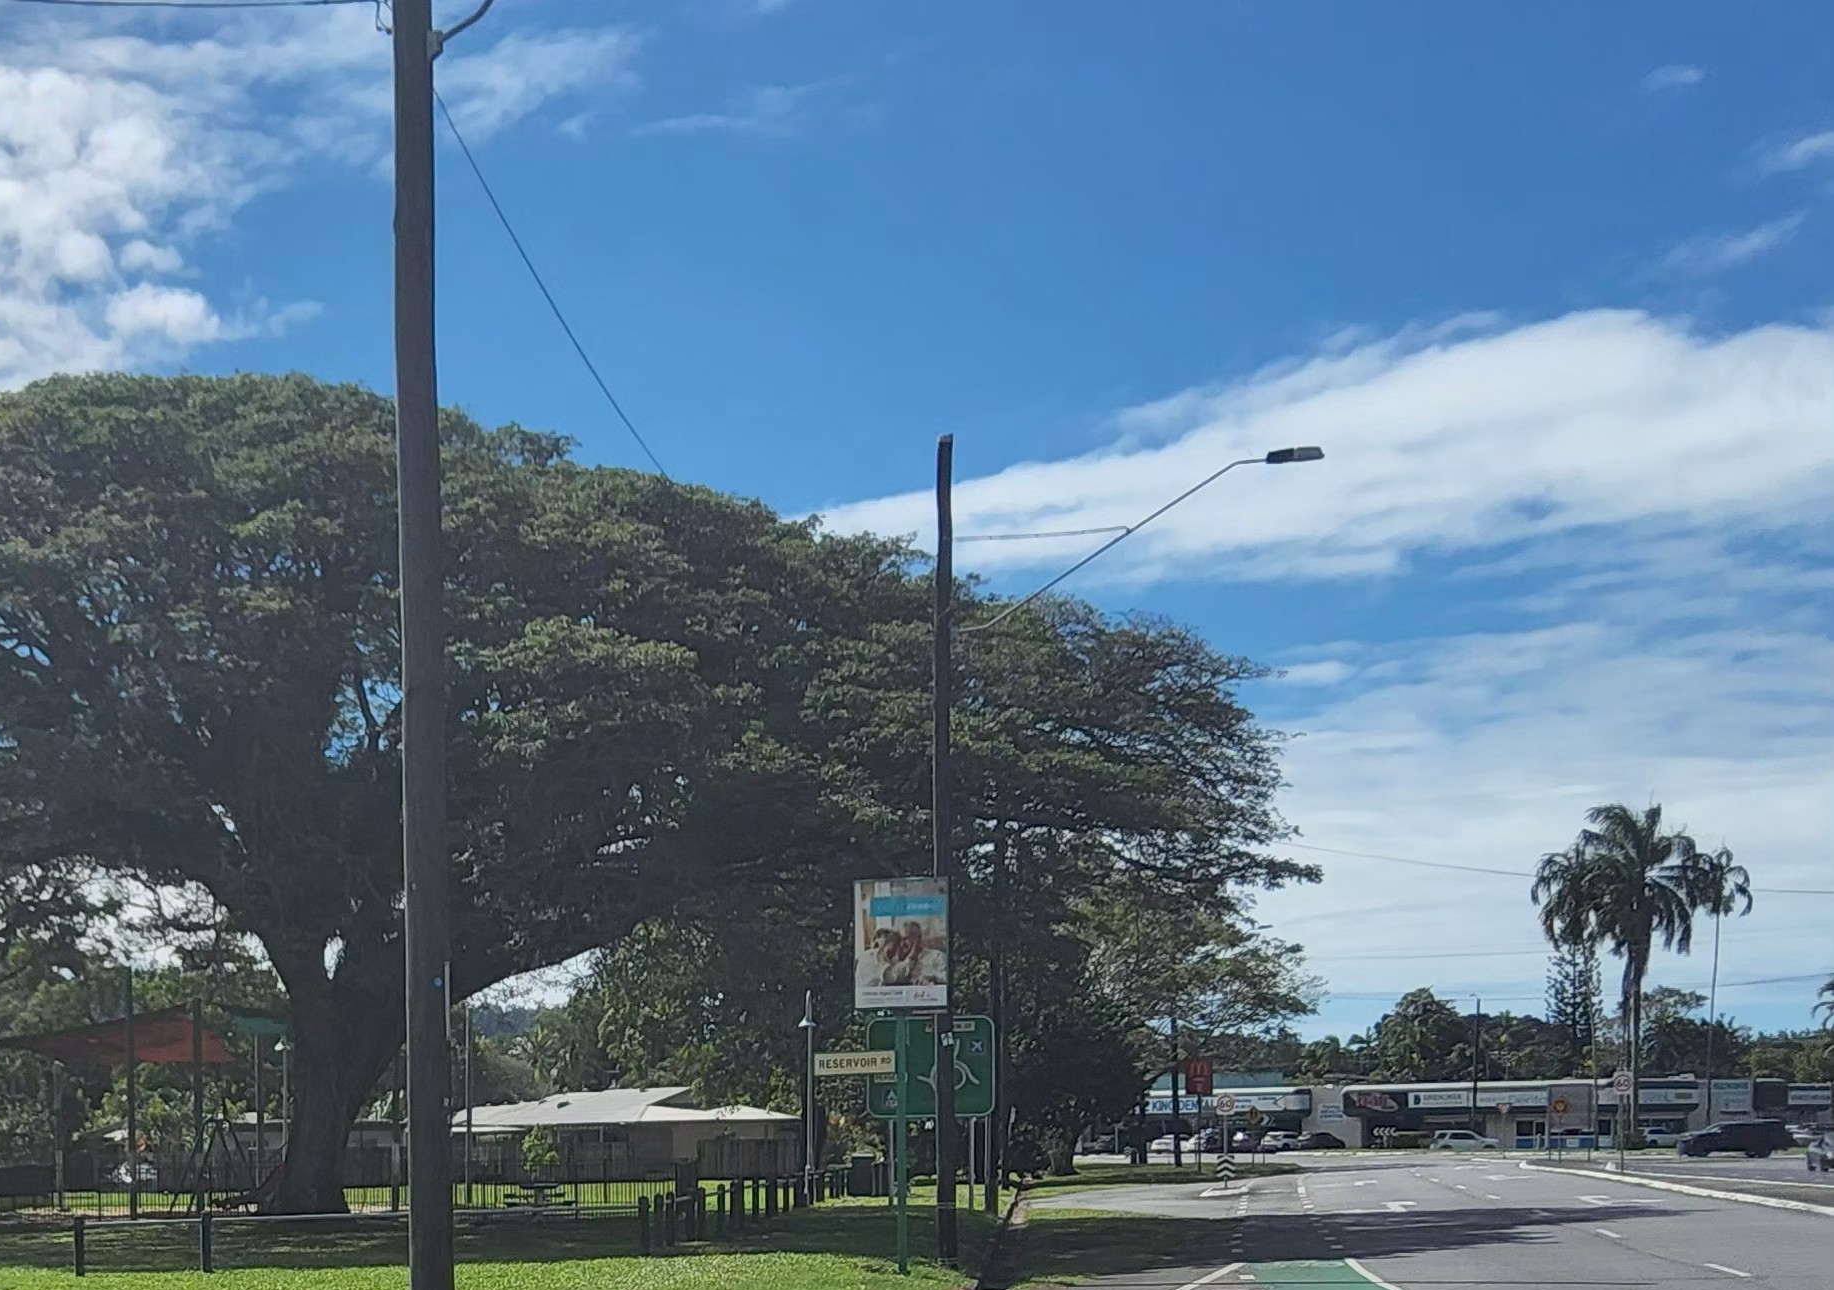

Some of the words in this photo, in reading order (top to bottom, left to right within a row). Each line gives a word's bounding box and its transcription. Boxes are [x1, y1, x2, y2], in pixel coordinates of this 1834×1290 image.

[818, 1056, 878, 1070] RESERVOIR
[880, 1056, 892, 1065] RD
[1617, 1079, 1630, 1087] 60
[1219, 1098, 1232, 1108] 60
